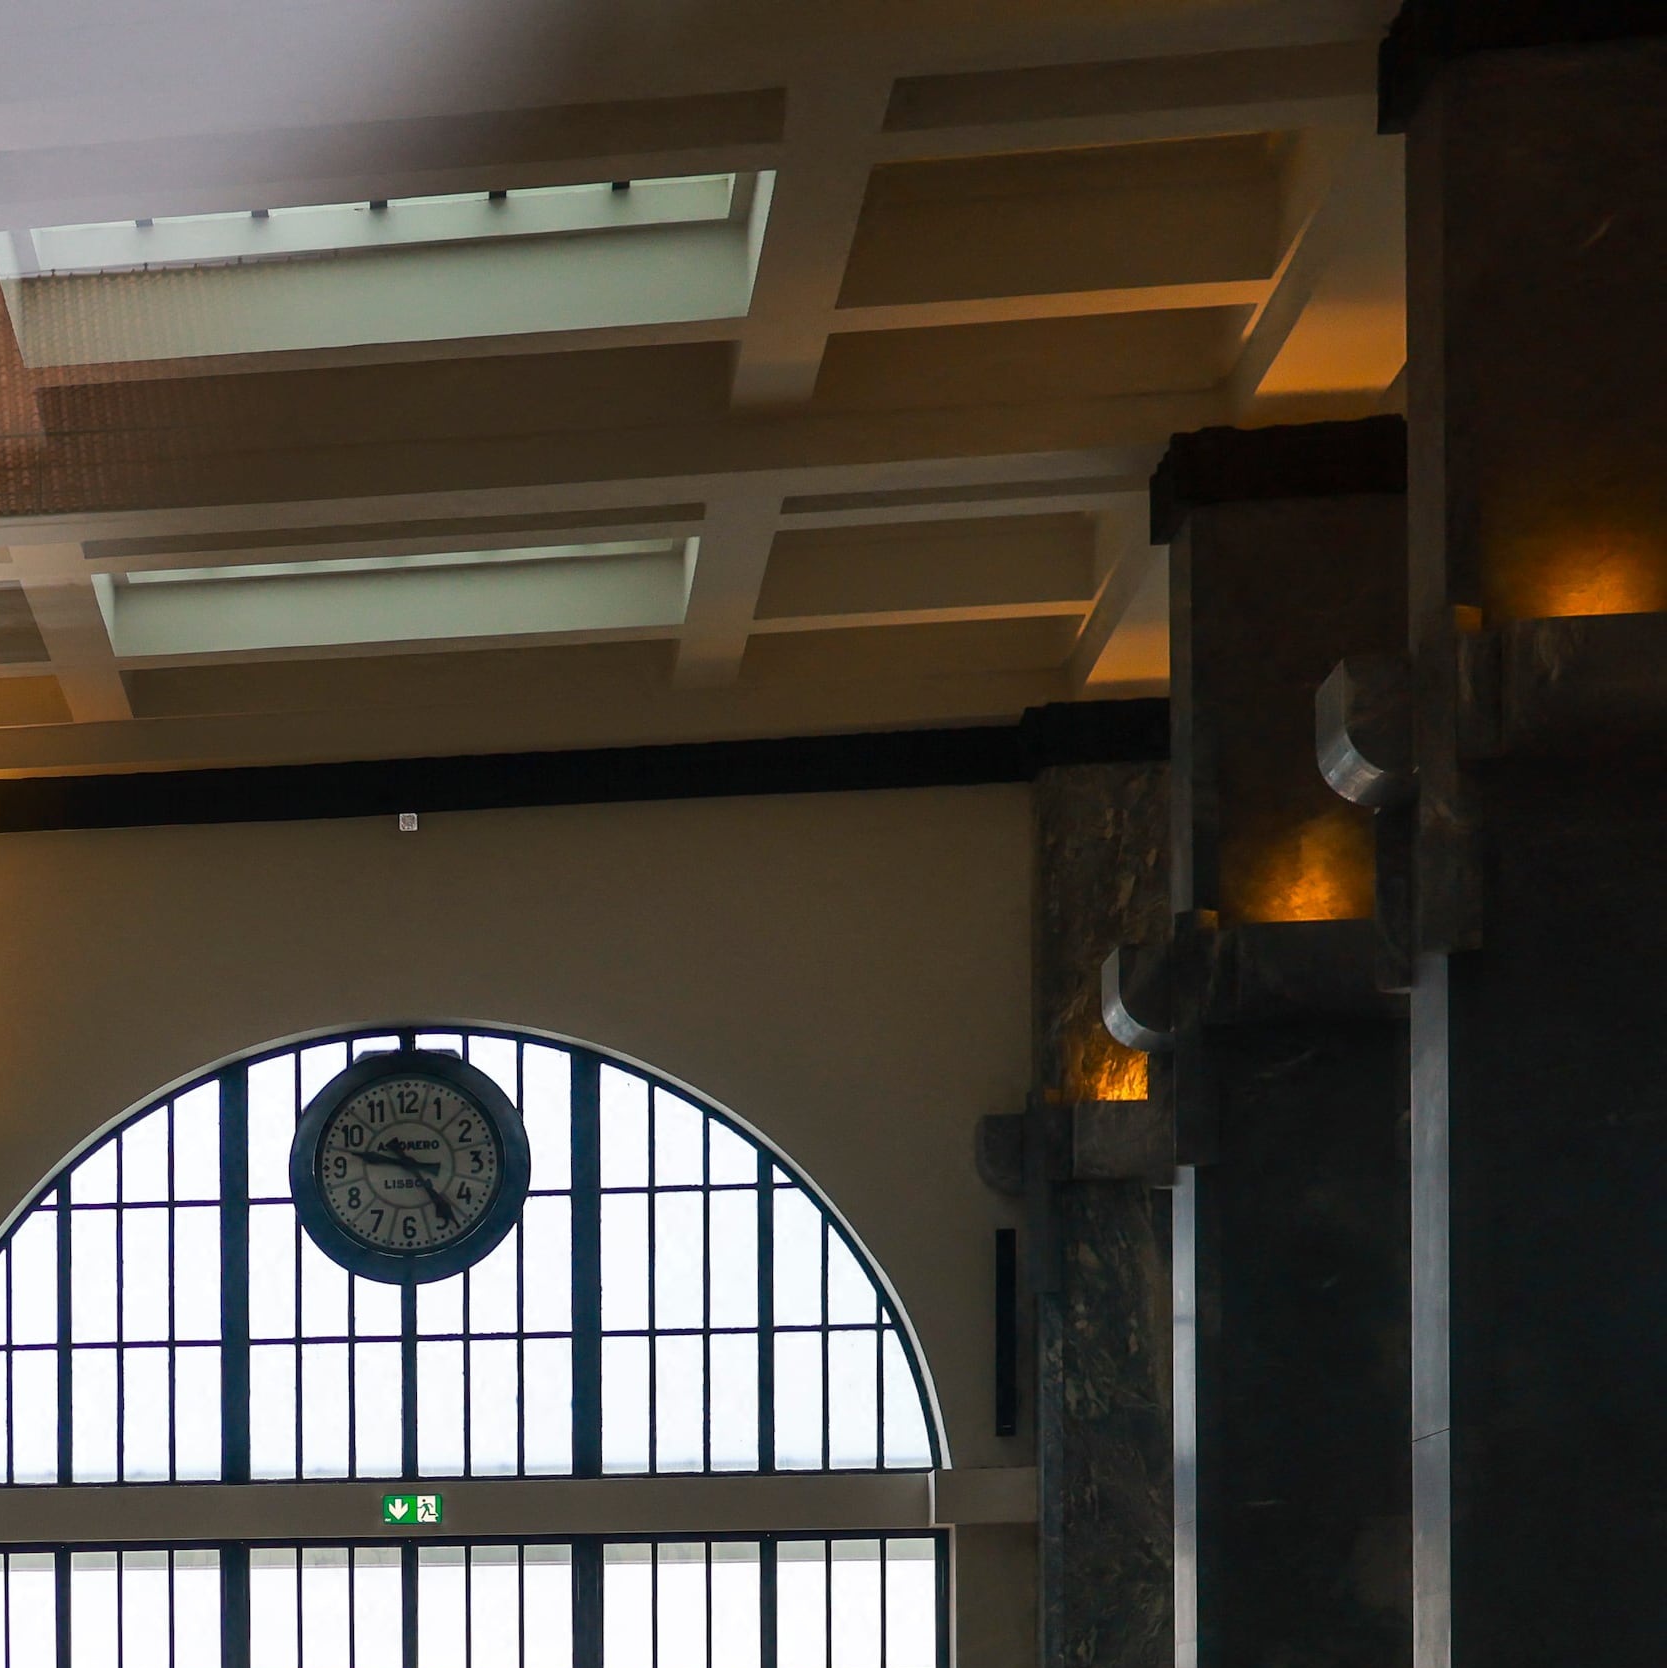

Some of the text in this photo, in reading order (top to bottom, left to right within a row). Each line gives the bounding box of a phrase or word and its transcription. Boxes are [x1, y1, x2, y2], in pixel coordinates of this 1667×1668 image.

[367, 1099, 385, 1123] 11
[396, 1090, 419, 1114] 12
[433, 1096, 442, 1120] 1
[341, 1124, 364, 1147] 10
[458, 1119, 472, 1143] 2
[333, 1156, 347, 1179] 9
[470, 1150, 484, 1174] 3
[347, 1186, 361, 1210] 8
[456, 1181, 472, 1205] 4
[370, 1209, 384, 1233] 7
[402, 1216, 417, 1239] 6
